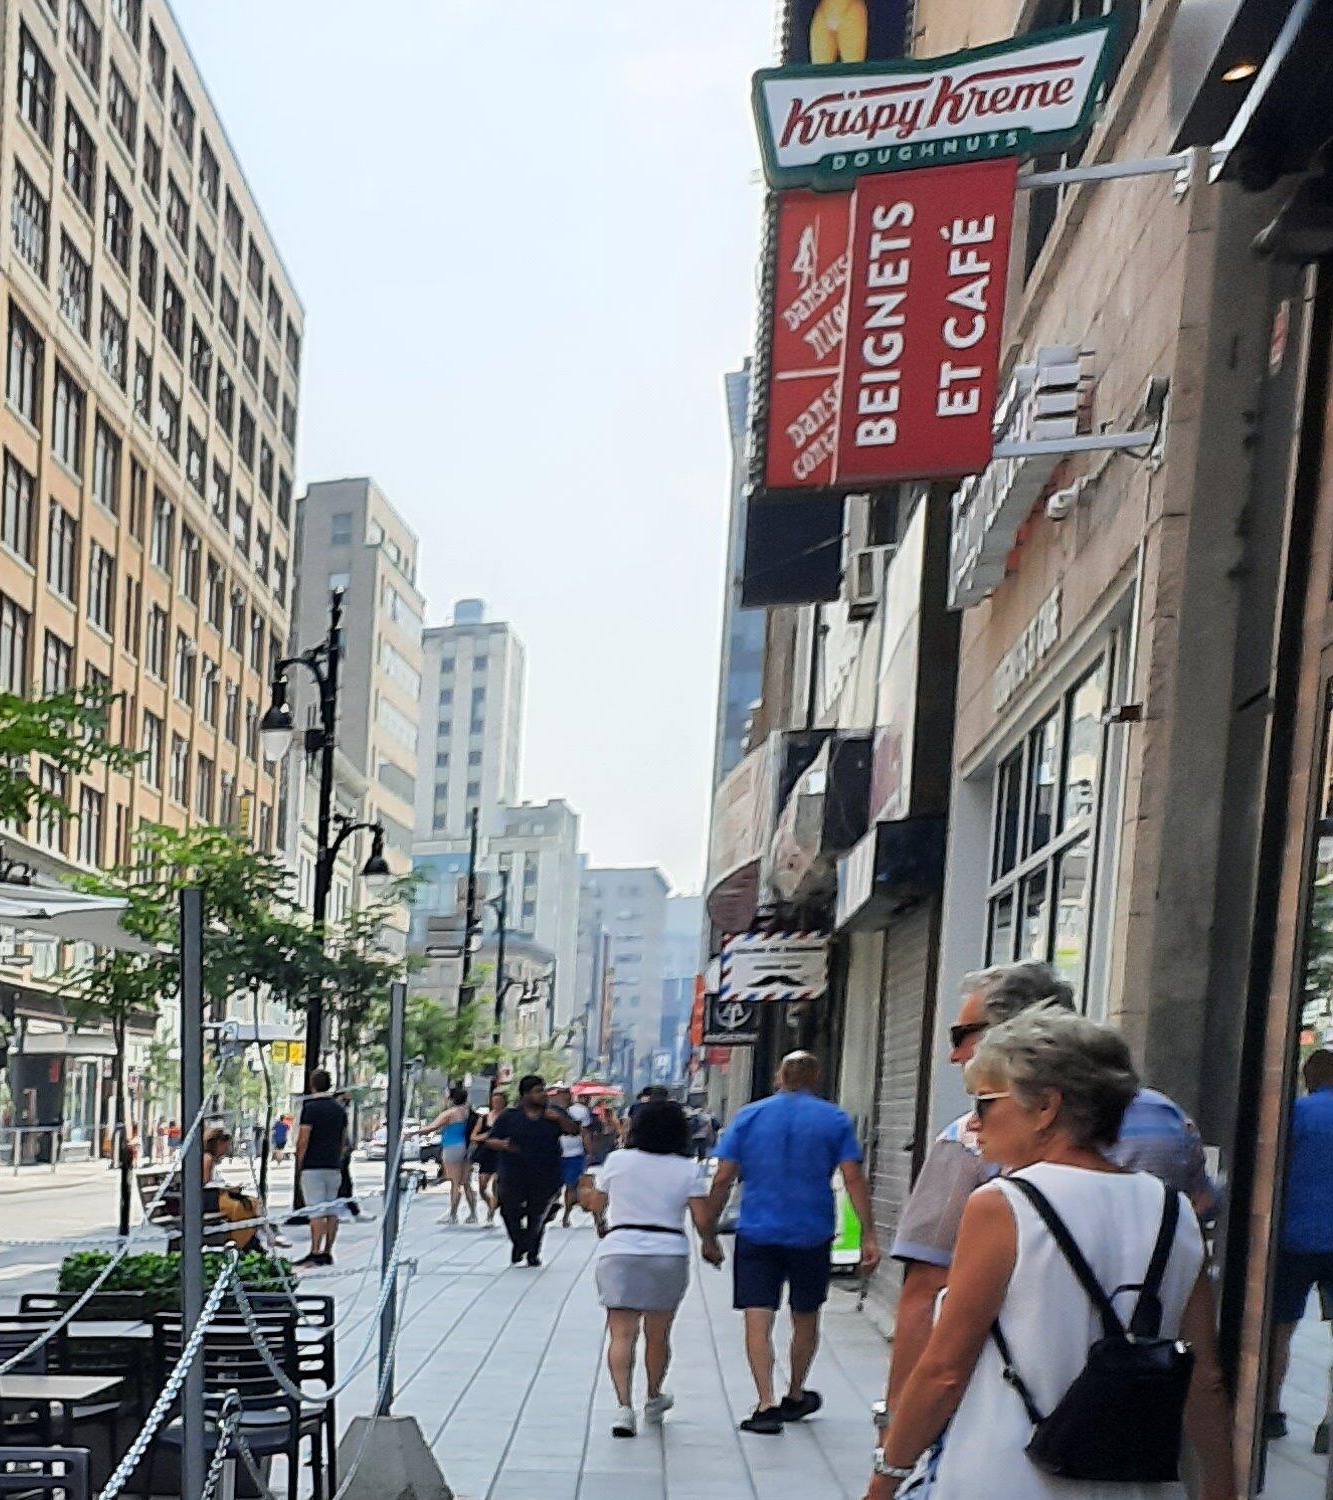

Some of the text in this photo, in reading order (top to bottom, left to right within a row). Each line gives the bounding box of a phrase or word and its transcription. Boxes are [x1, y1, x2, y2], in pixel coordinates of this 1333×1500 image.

[779, 54, 1086, 148] Krispy Kreme
[832, 130, 1021, 171] DOUGHNUTS
[855, 200, 916, 447] BEIGNETS
[937, 213, 996, 416] ET CAFÉ
